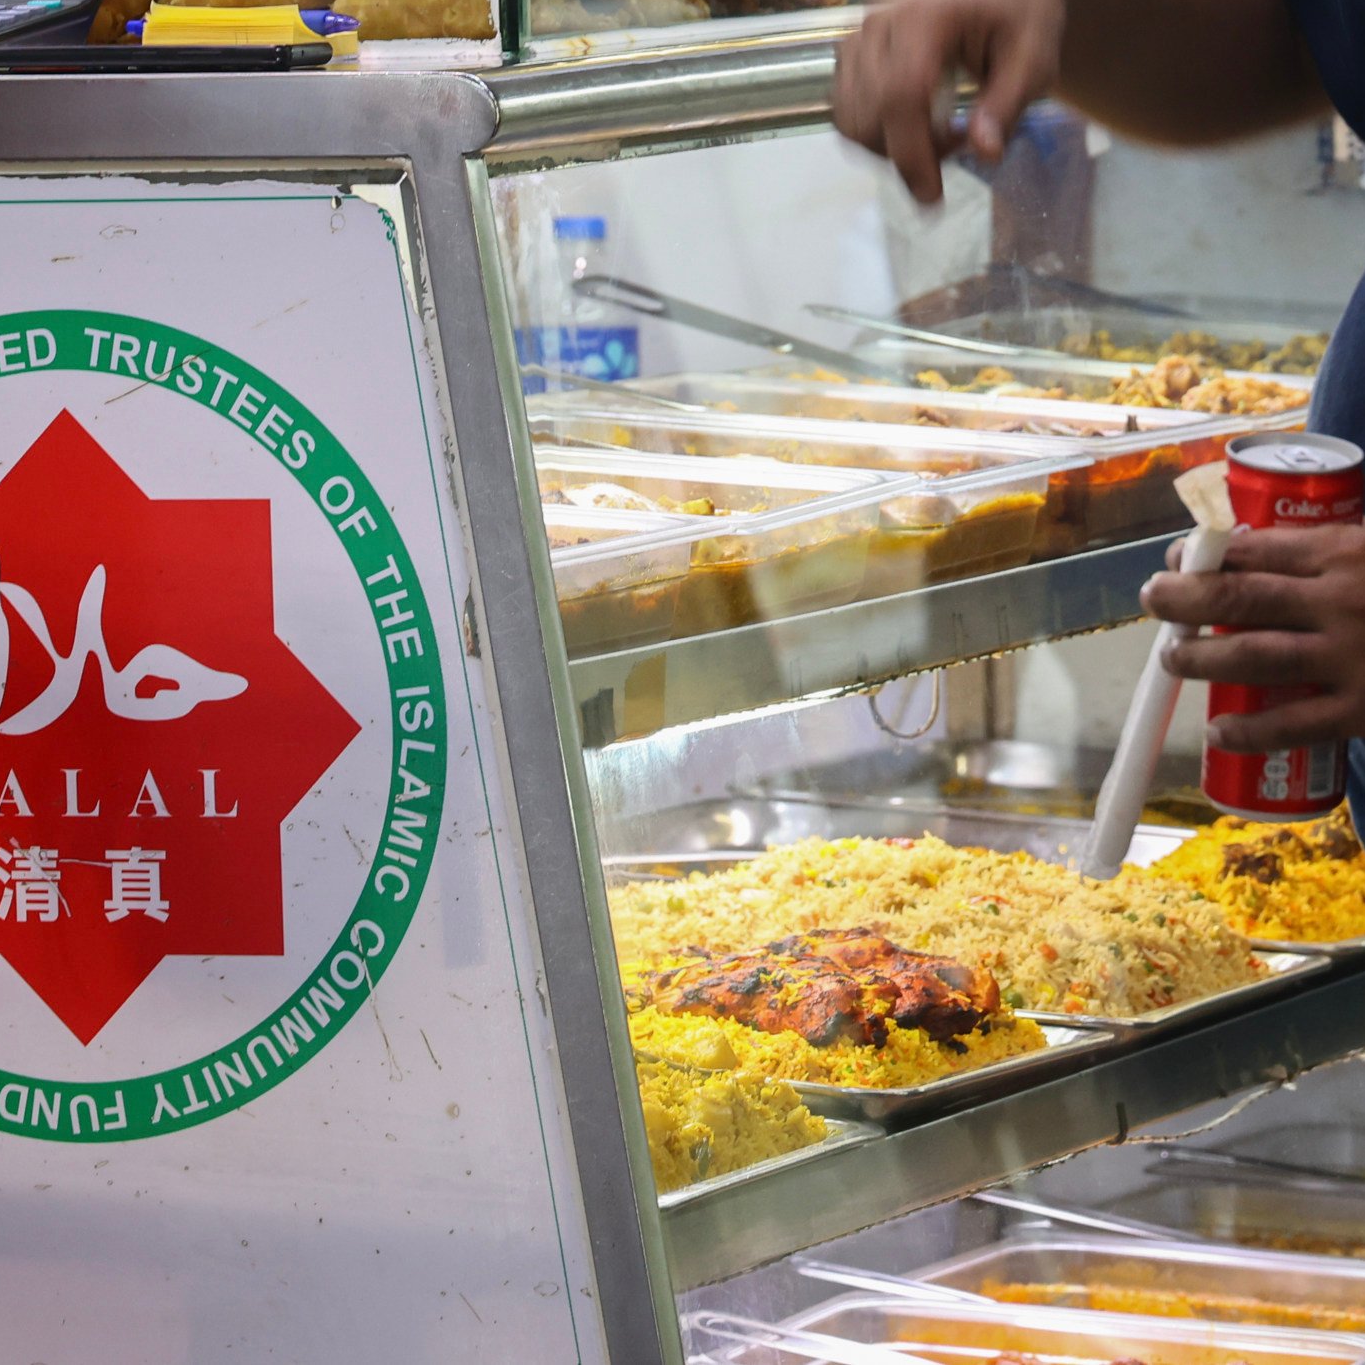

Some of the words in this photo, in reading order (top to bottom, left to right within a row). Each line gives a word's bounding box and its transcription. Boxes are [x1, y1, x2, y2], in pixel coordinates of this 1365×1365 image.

[84, 327, 317, 470] TRUSTEES
[319, 475, 378, 540] OF
[366, 555, 423, 665] THE
[375, 687, 435, 902] ISLAMIC
[151, 919, 385, 1125] COMMUNITY
[0, 1086, 127, 1131] FUND
